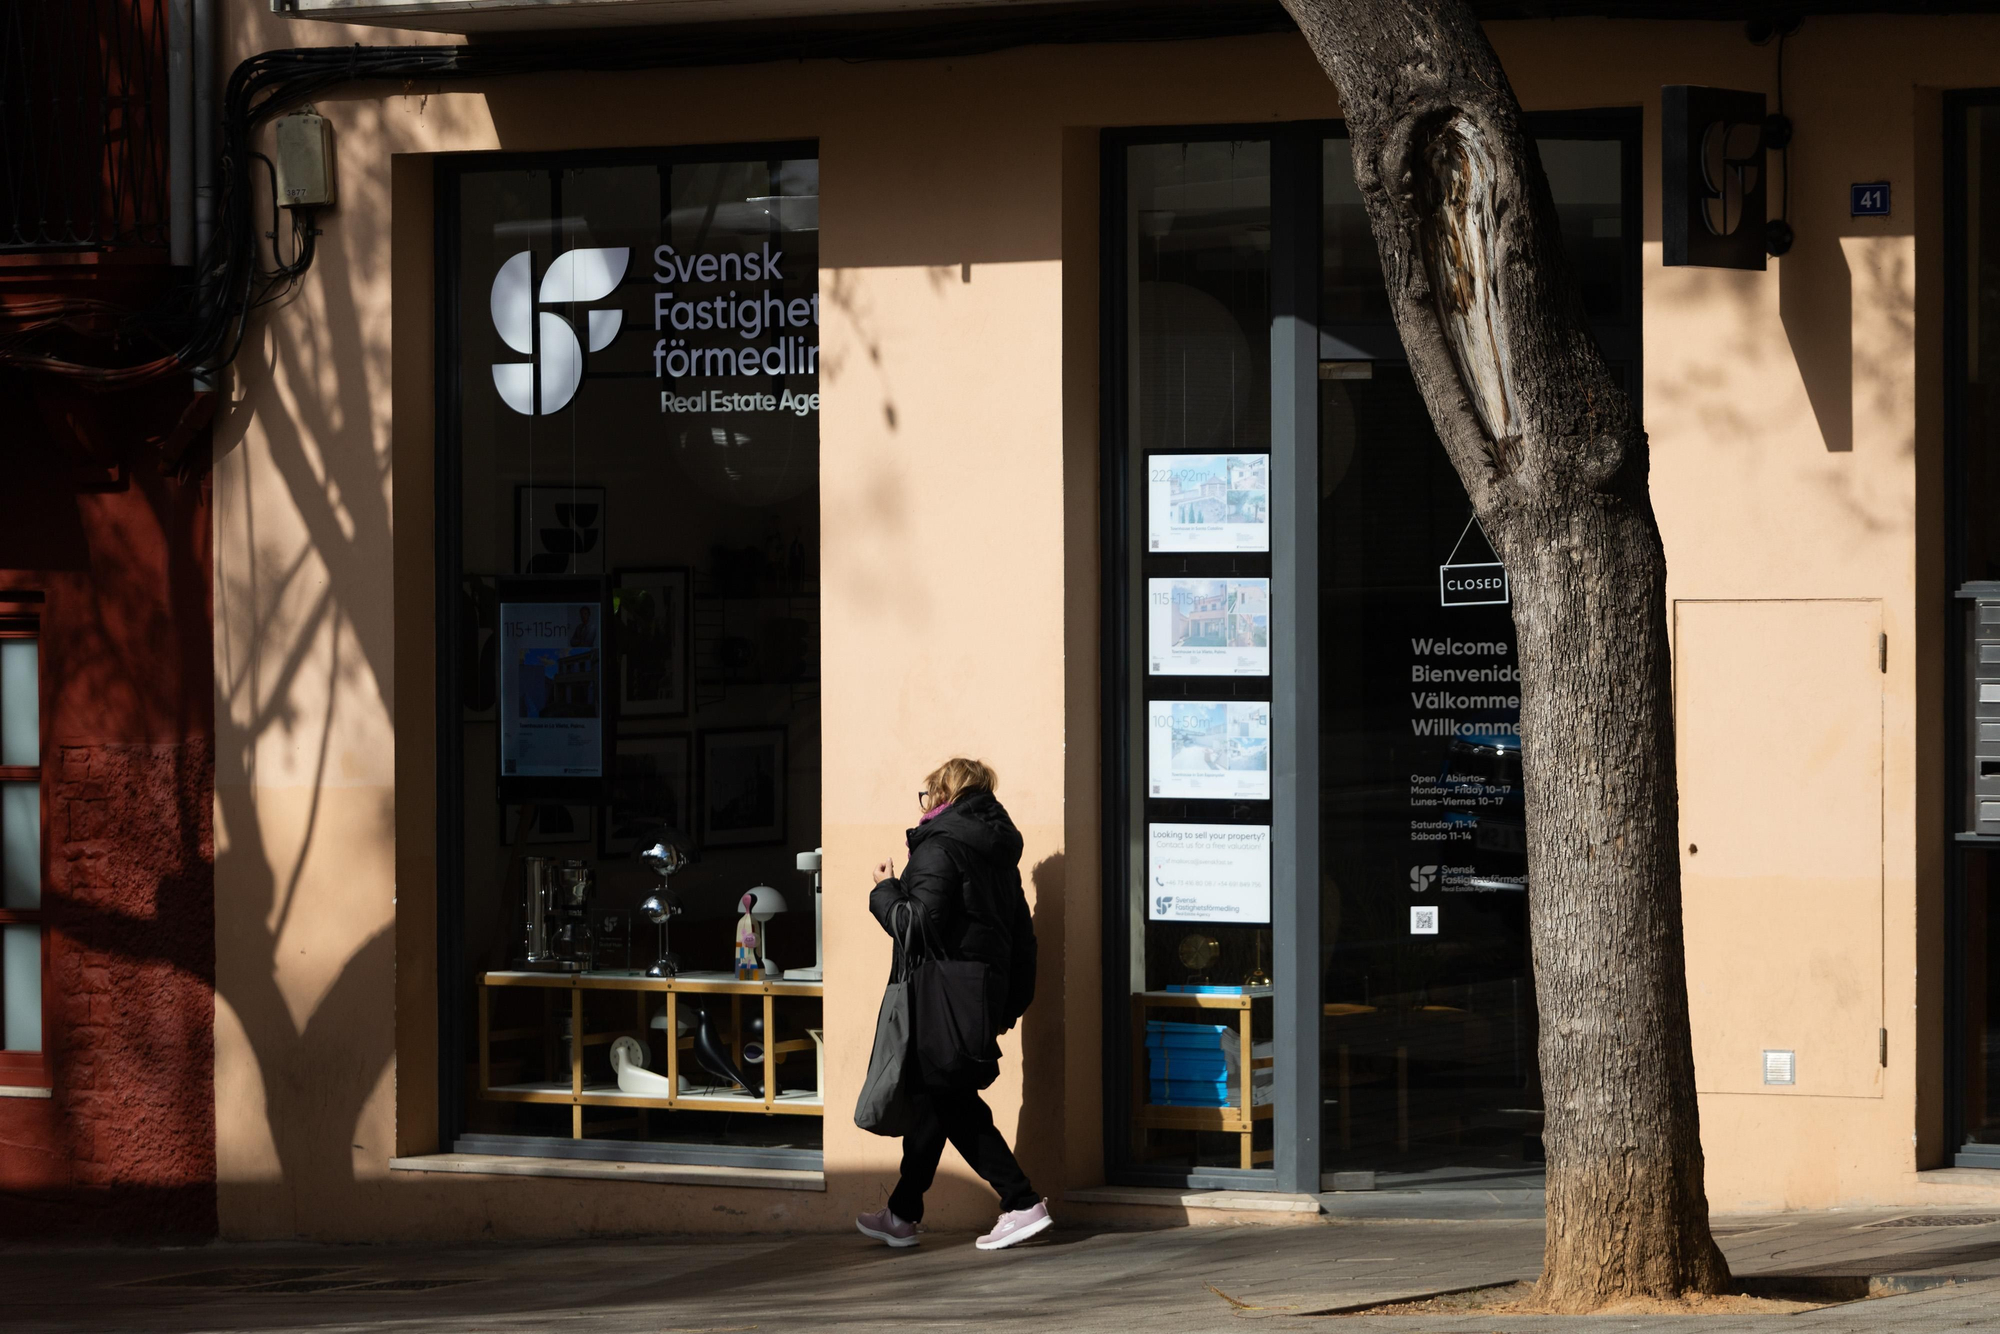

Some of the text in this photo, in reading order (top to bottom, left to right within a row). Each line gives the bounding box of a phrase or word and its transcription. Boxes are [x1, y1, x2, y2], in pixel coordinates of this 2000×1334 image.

[1860, 190, 1881, 208] 41
[653, 242, 783, 284] Svensk
[661, 391, 707, 412] Real
[711, 390, 775, 411] Estate
[1447, 578, 1502, 590] CLOSED
[1411, 637, 1508, 655] Welcome
[1411, 691, 1520, 709] Välkomme
[1410, 774, 1436, 784] Open
[1445, 773, 1480, 782] Abierto
[1411, 820, 1454, 830] Saturday
[1153, 830, 1182, 840] Looking
[1228, 833, 1266, 842] property?
[1411, 832, 1448, 841] Sábado
[1441, 865, 1475, 874] Svensk
[1176, 904, 1240, 914] Fastighetsförmedling
